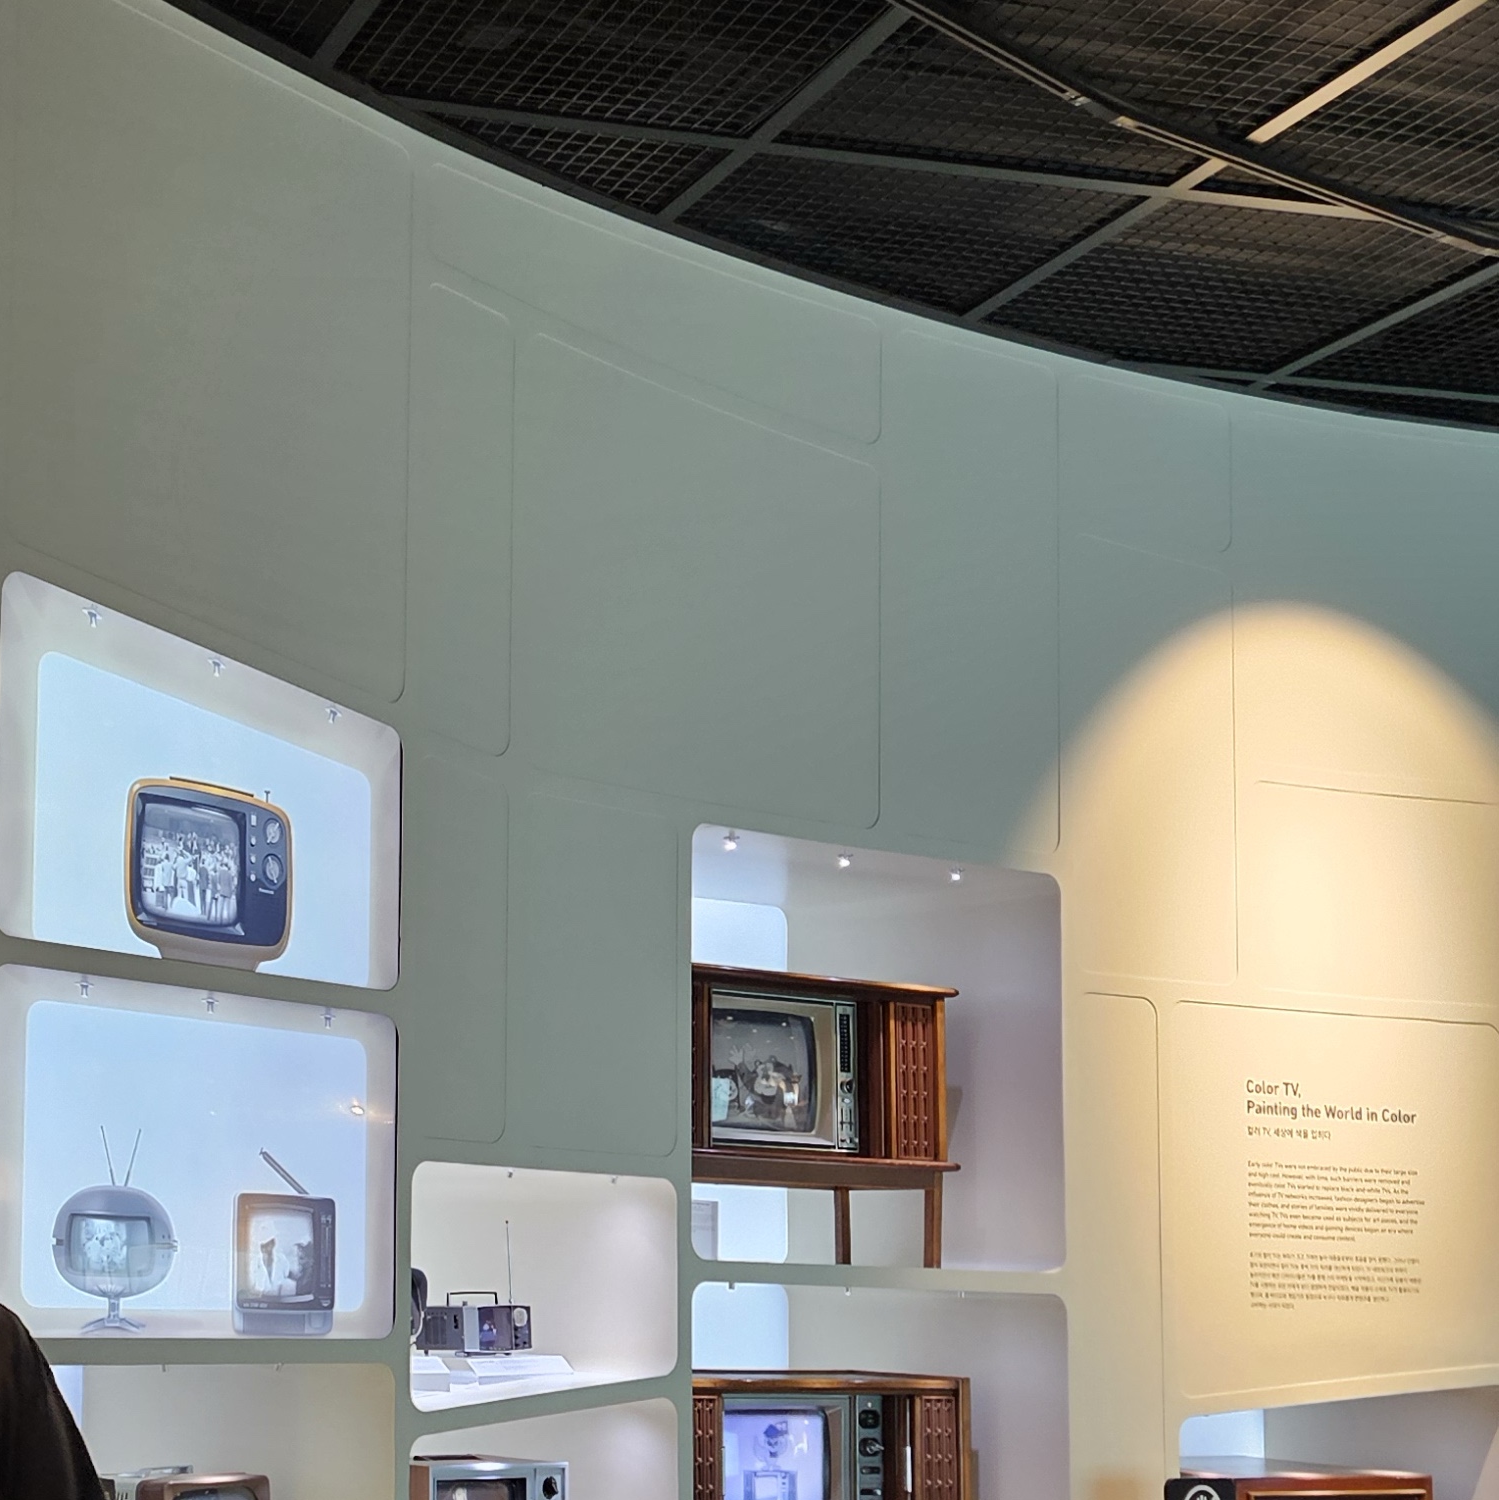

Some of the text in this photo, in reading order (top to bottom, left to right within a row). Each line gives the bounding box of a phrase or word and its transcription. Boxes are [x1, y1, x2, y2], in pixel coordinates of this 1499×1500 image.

[1246, 1079, 1302, 1099] Color TV,
[1246, 1100, 1417, 1125] Painting the World in Color
